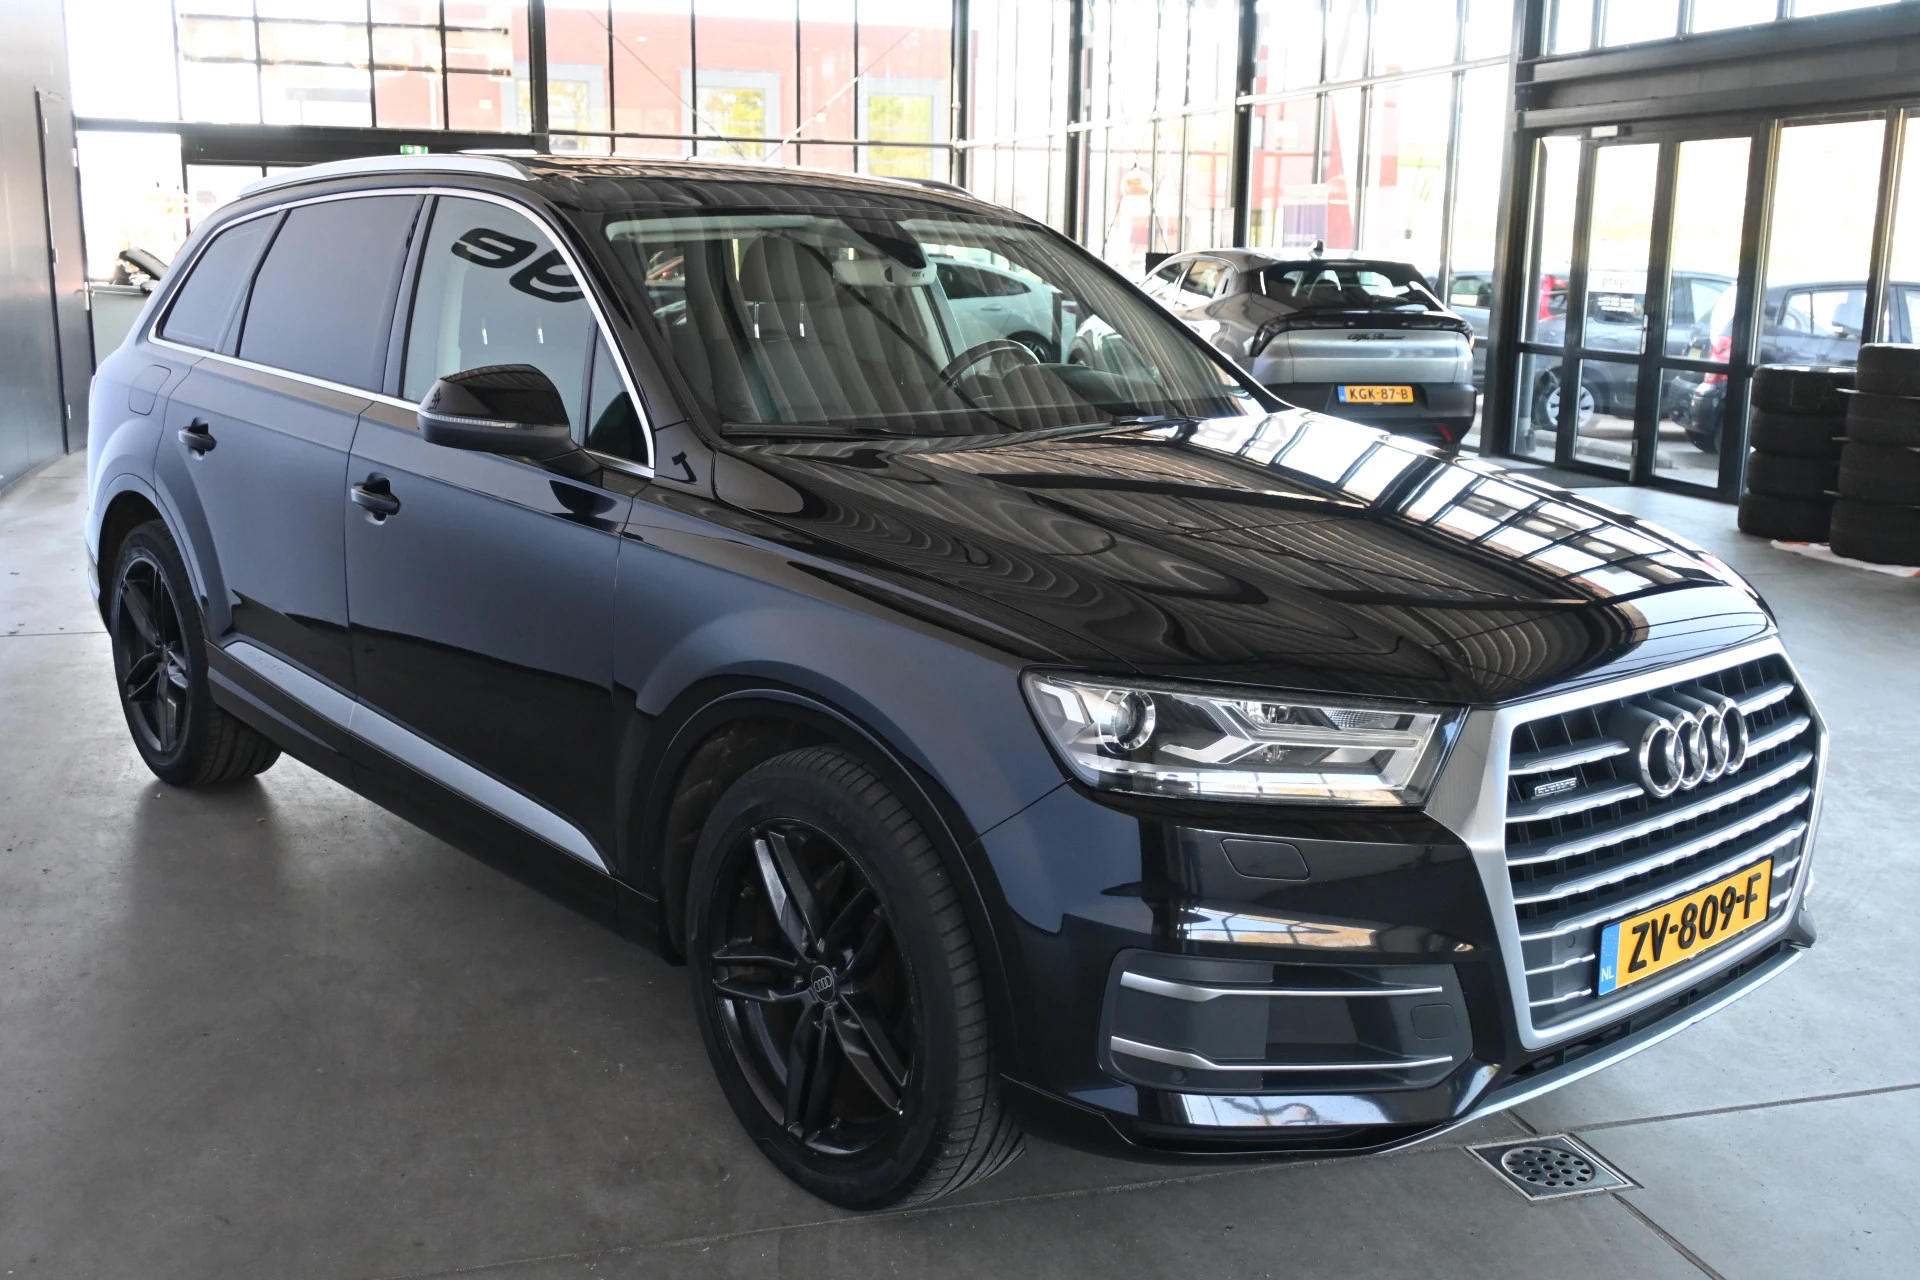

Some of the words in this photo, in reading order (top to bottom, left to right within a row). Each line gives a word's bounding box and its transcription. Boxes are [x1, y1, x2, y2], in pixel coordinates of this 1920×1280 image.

[1349, 388, 1409, 400] KGK-87-B
[1628, 872, 1762, 973] ZV-809-F
[1601, 965, 1614, 982] NL
